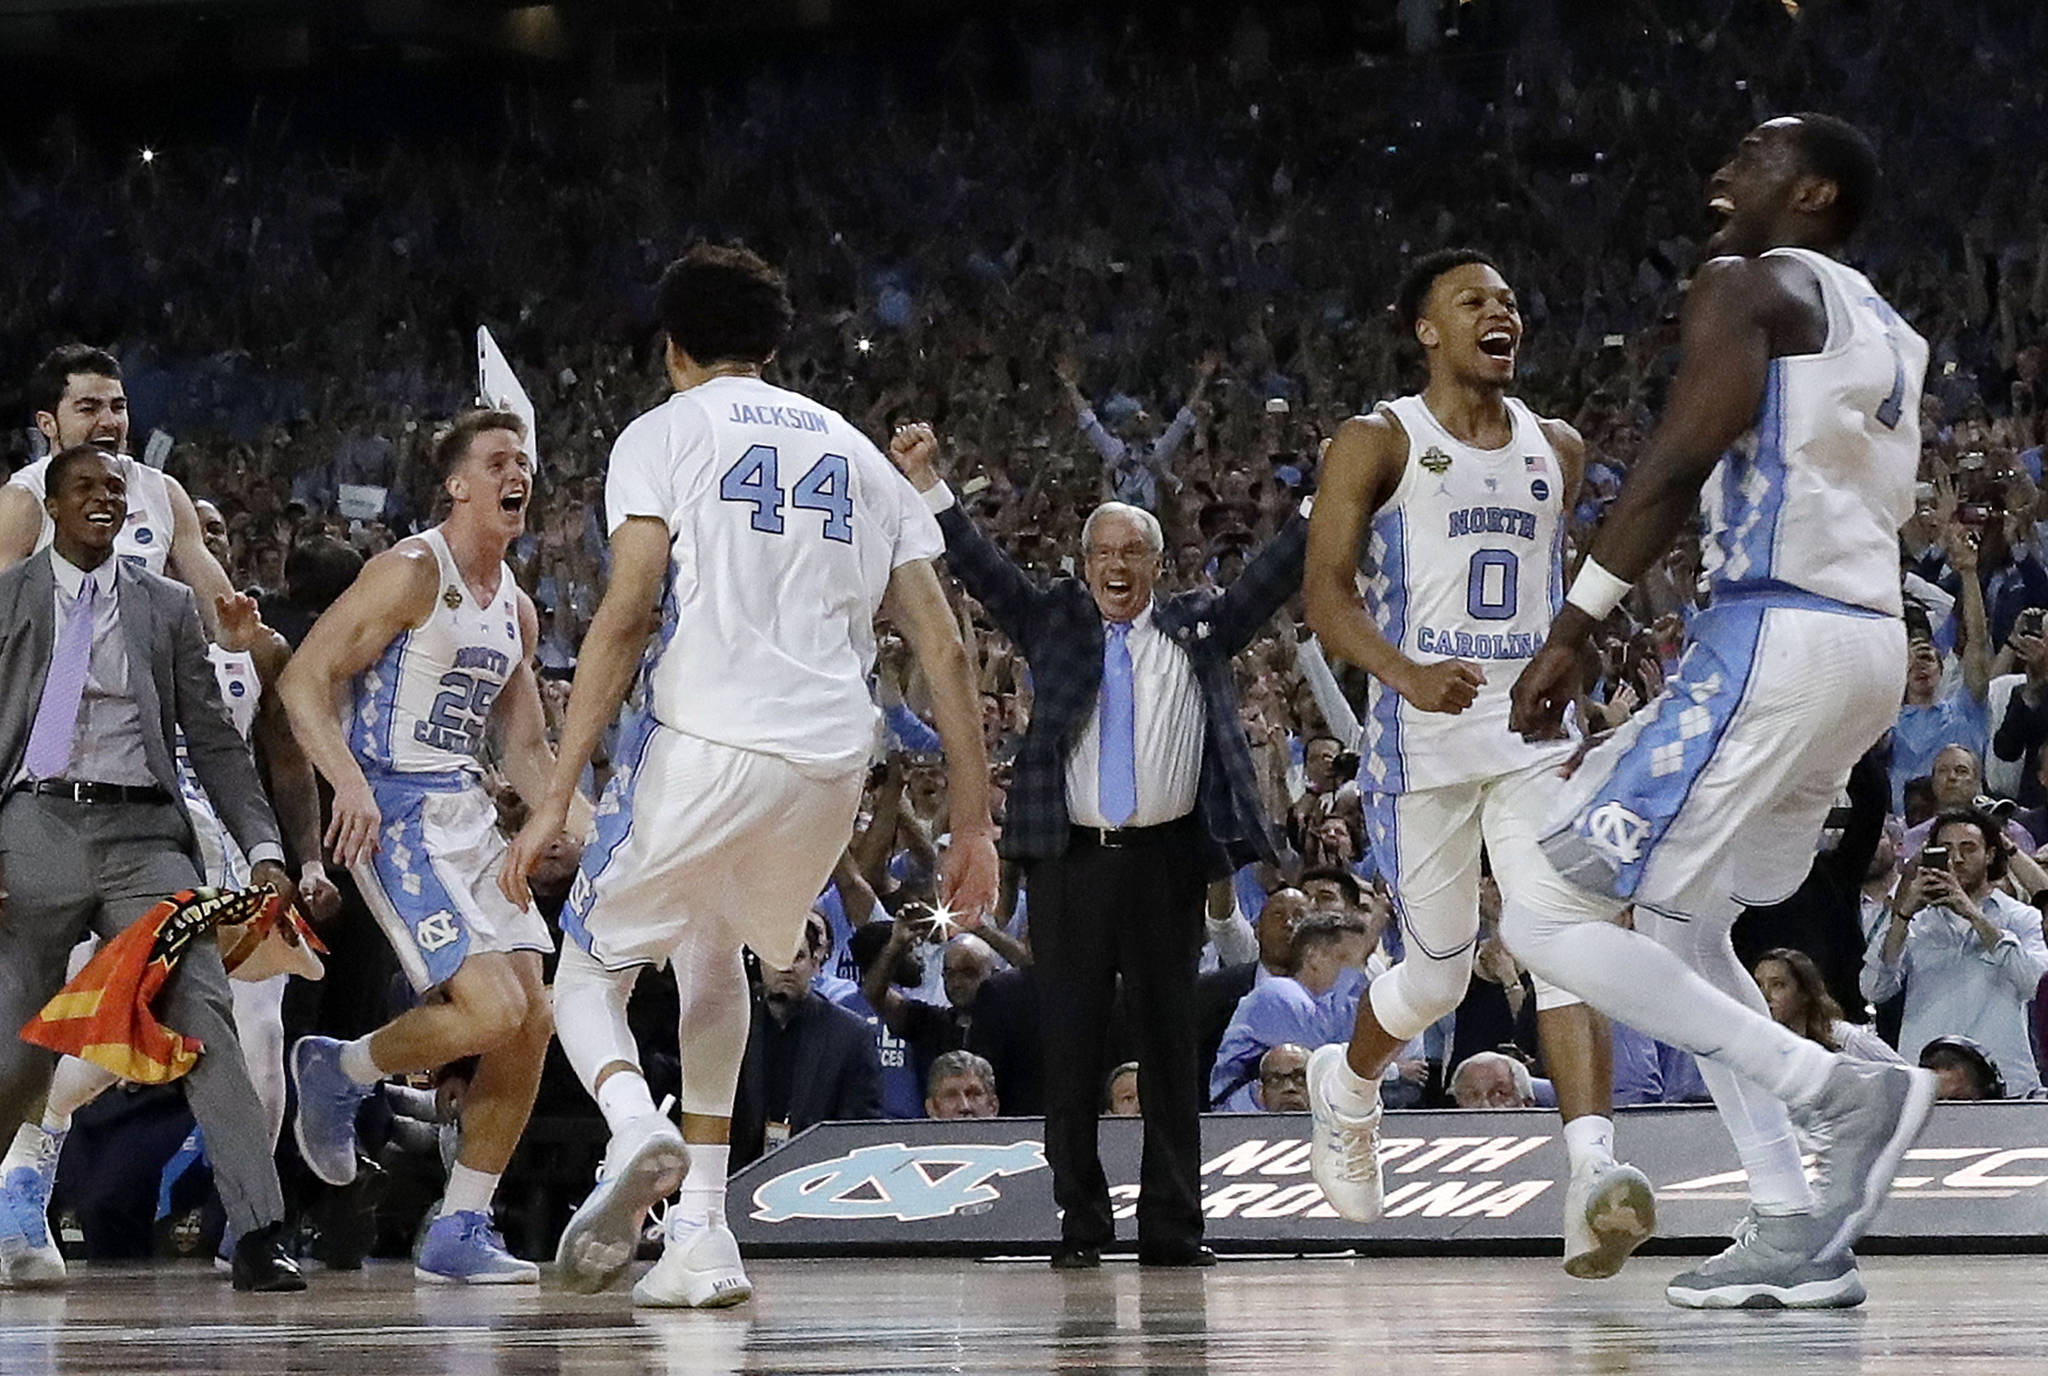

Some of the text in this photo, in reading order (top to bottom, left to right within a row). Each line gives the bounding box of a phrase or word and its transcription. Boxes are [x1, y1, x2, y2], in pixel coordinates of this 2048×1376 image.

[729, 403, 829, 434] JACKSON
[720, 444, 853, 544] 44
[1449, 507, 1537, 540] NORTH
[1467, 549, 1518, 620] 0
[1418, 627, 1544, 660] CAROLINA
[429, 671, 501, 739] 25
[1057, 1180, 1555, 1219] CROINA
